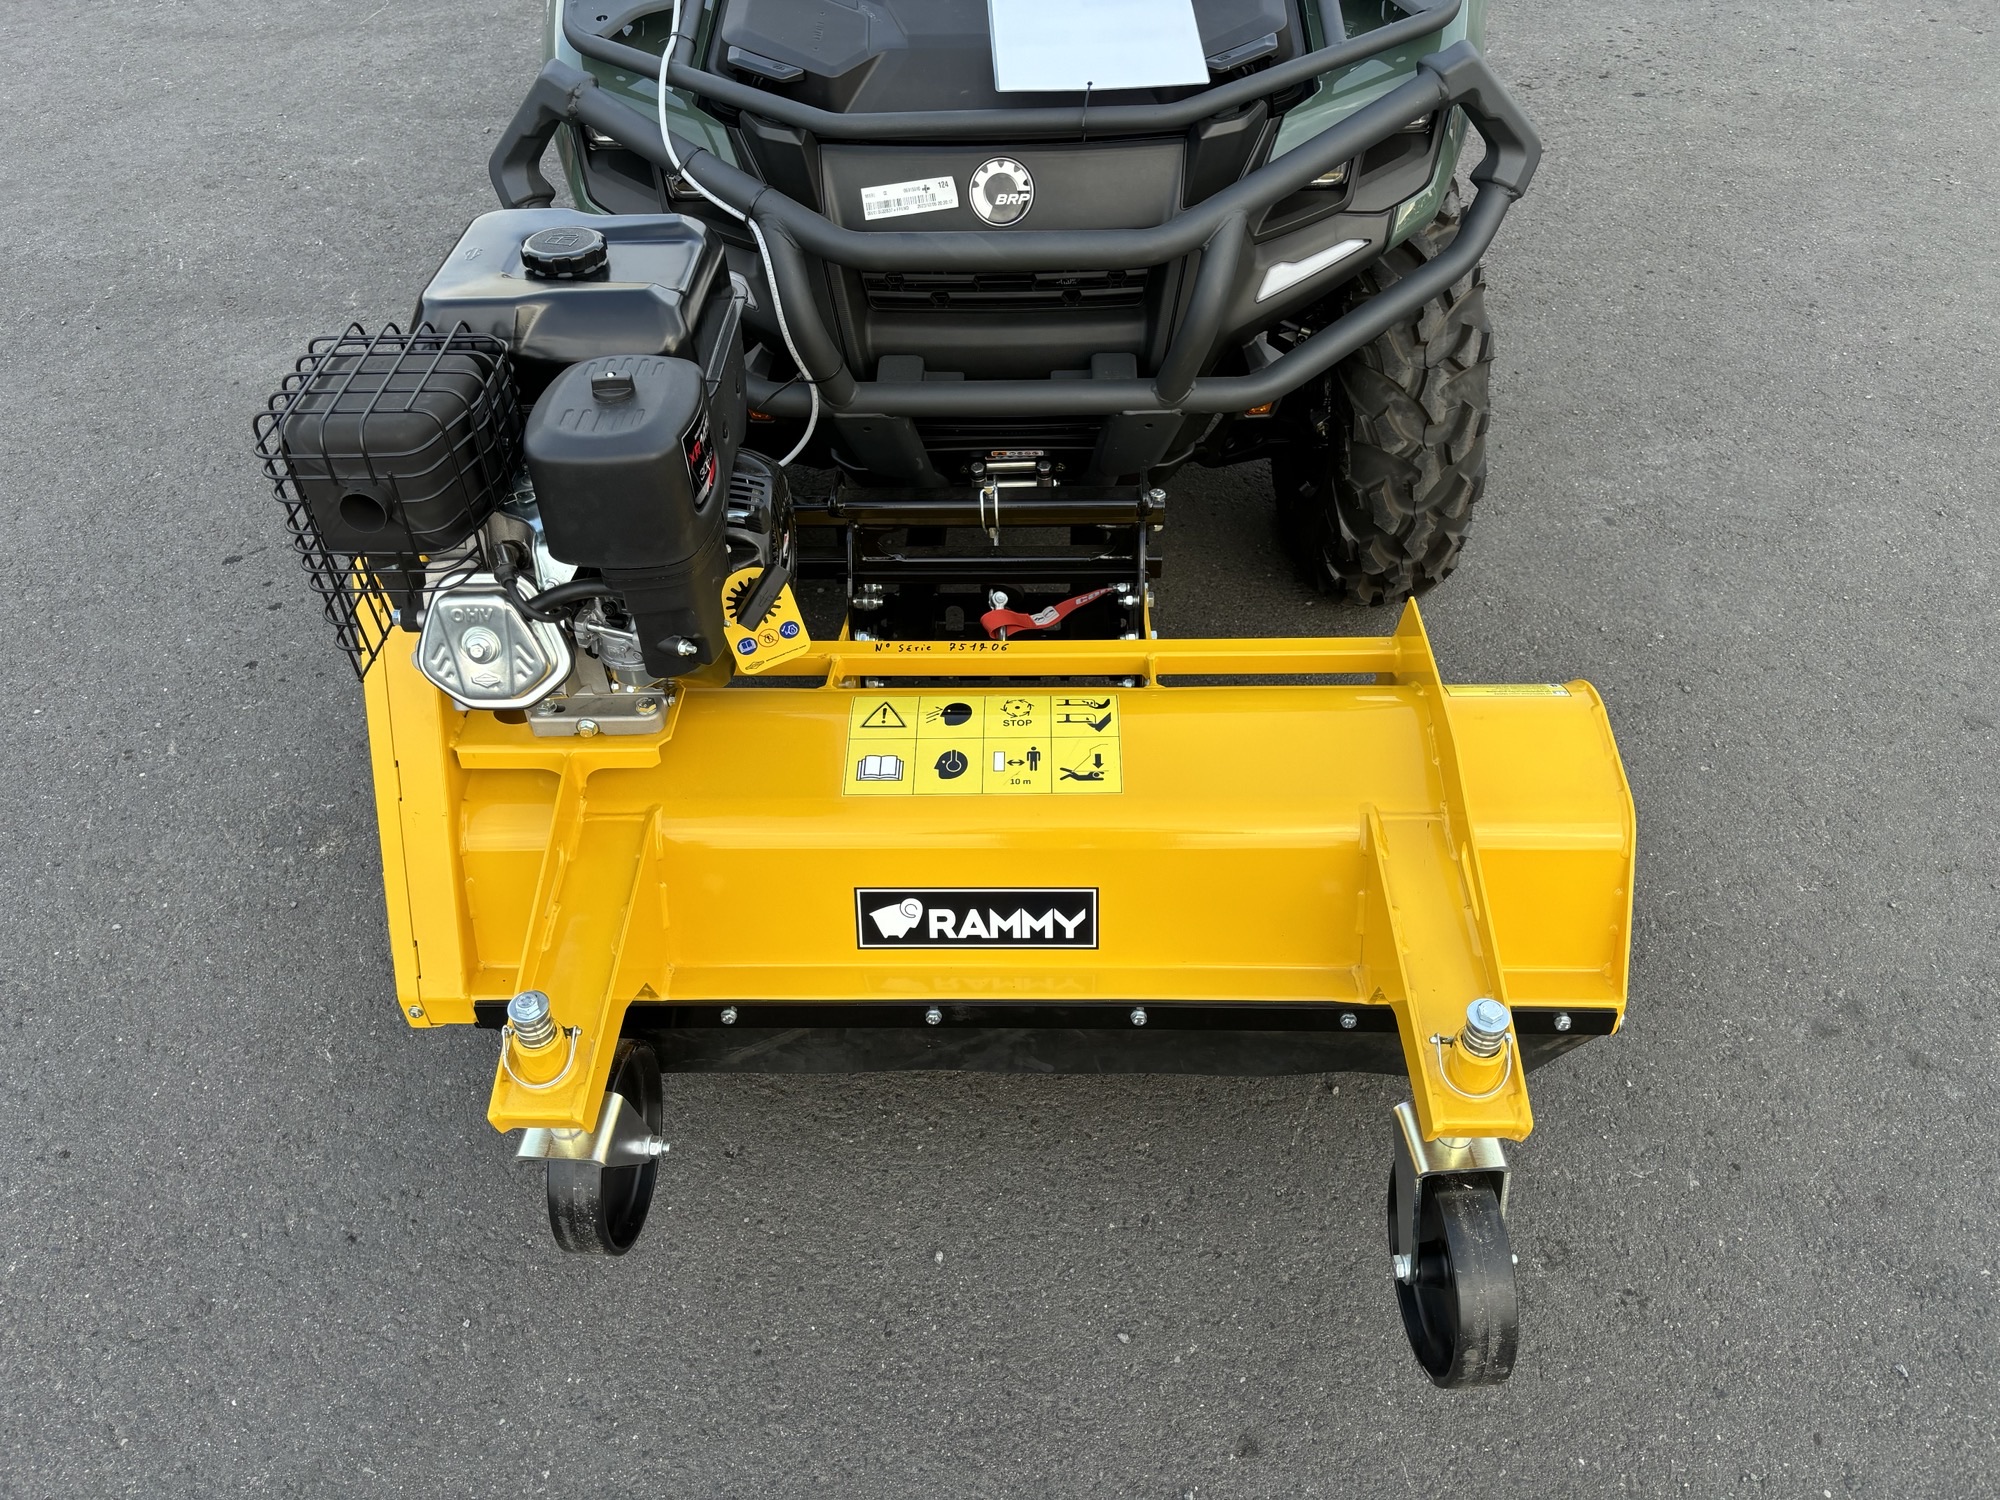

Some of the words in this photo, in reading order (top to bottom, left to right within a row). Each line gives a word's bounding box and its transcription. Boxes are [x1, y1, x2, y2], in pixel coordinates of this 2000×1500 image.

[938, 180, 949, 189] 124
[995, 193, 1030, 205] BRP
[451, 607, 493, 623] OHV
[1003, 719, 1032, 727] STOP
[928, 907, 1087, 939] RAMMY
